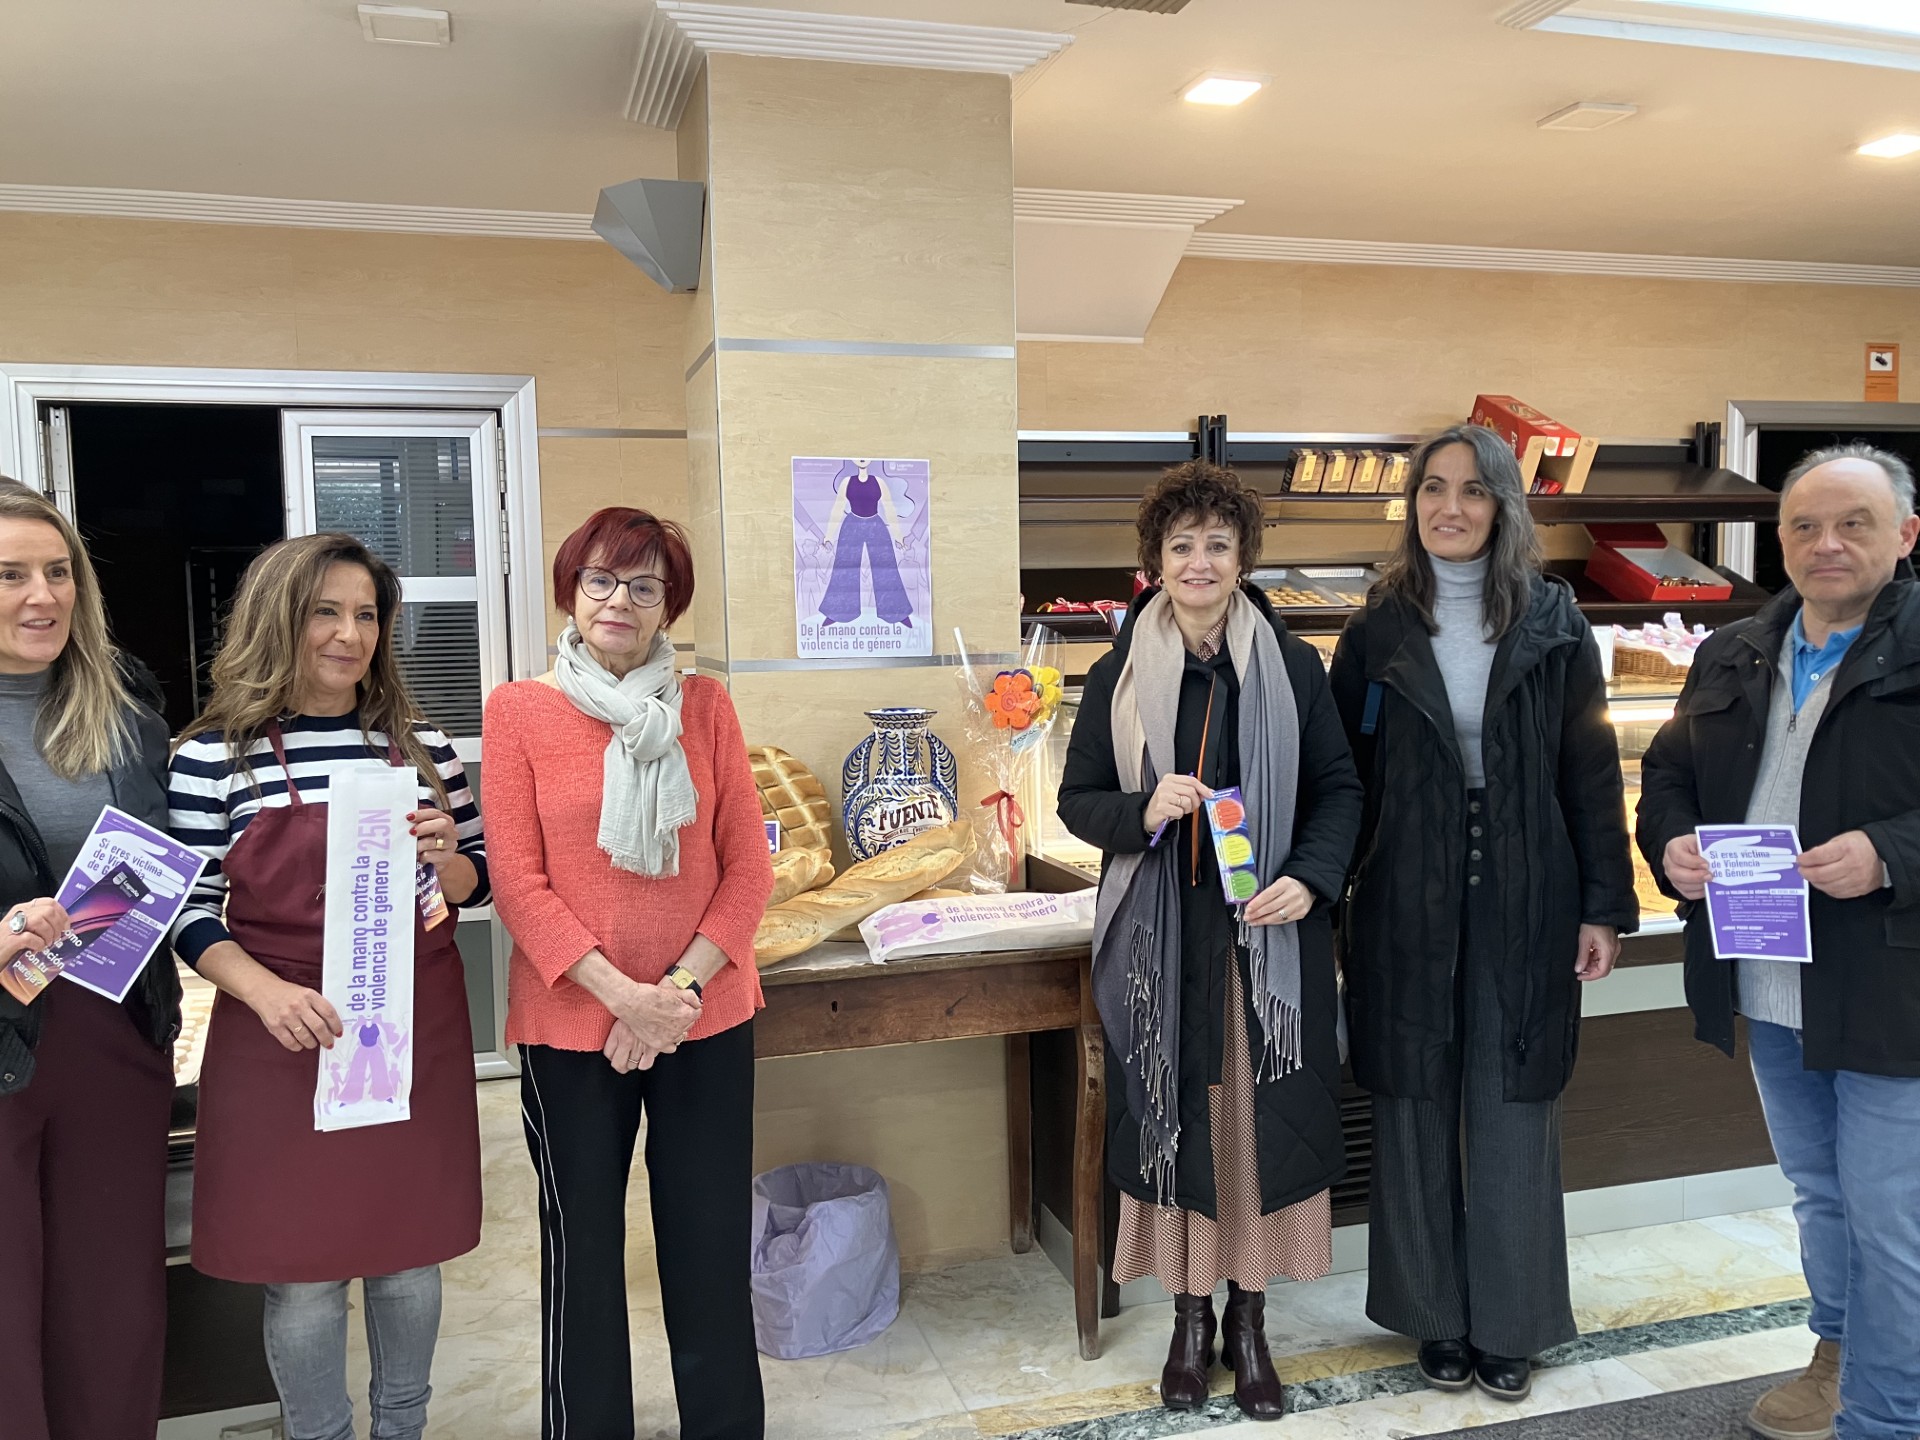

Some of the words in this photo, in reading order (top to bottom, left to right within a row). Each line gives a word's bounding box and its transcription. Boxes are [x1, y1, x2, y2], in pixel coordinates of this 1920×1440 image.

[801, 623, 813, 637] De
[816, 623, 826, 637] la
[828, 625, 856, 636] mano
[859, 623, 890, 636] contra
[893, 622, 902, 635] la
[801, 637, 849, 651] violencia
[852, 637, 865, 649] de
[867, 637, 902, 653] género
[357, 809, 392, 853] 25N
[92, 848, 104, 862] de
[107, 853, 146, 881] Viocia
[99, 837, 111, 850] Si
[110, 844, 131, 861] eres
[132, 855, 163, 878] víctima
[351, 855, 371, 870] la
[1709, 850, 1721, 860] Si
[1720, 851, 1738, 859] eres
[1741, 850, 1770, 859] víctima
[1711, 860, 1722, 869] de
[1723, 858, 1761, 868] Violencia
[87, 859, 100, 873] de
[1713, 869, 1723, 878] de
[1725, 868, 1754, 878] Género
[122, 880, 140, 898] Logroño
[369, 860, 393, 914] género
[350, 873, 370, 923] contra
[420, 892, 430, 905] con
[945, 905, 960, 914] de
[962, 904, 973, 912] la
[975, 905, 1005, 913] mano
[1008, 898, 1044, 912] contra
[1045, 894, 1057, 904] la
[949, 911, 1000, 924] violencia
[1003, 911, 1017, 919] de
[367, 918, 387, 937] de
[53, 937, 64, 949] la
[64, 928, 83, 947] ómo
[42, 945, 65, 970] ación
[352, 927, 368, 970] mano
[25, 950, 41, 967] con
[38, 960, 48, 973] tu
[13, 960, 43, 987] pareja?
[347, 974, 367, 989] la
[366, 941, 387, 1011] violencia
[346, 993, 366, 1012] de
